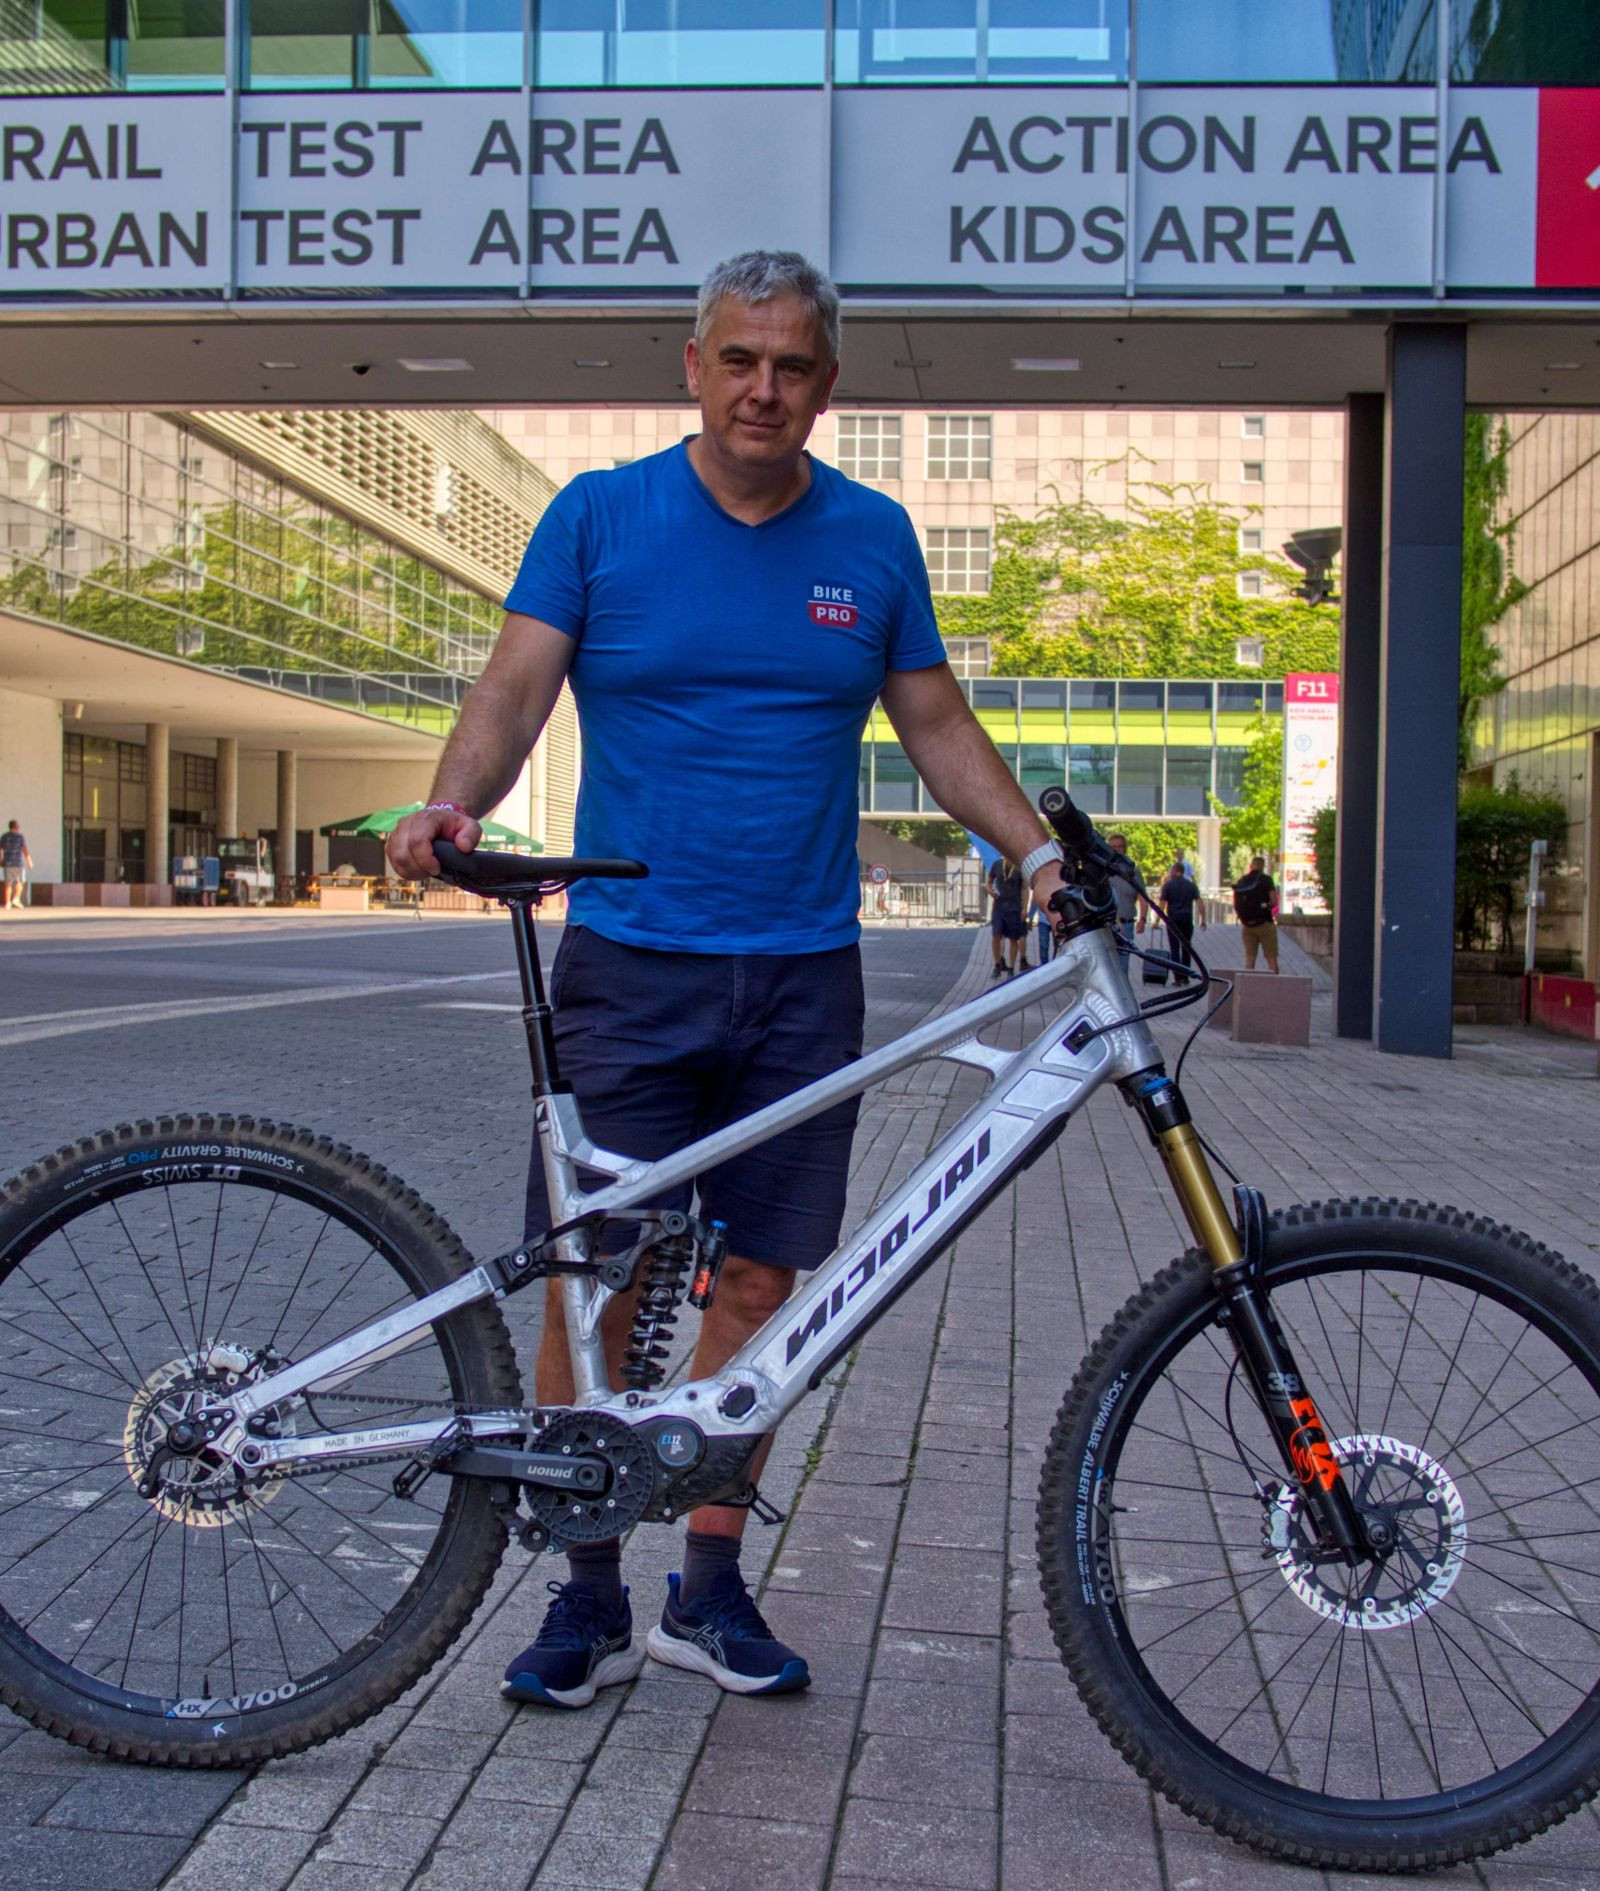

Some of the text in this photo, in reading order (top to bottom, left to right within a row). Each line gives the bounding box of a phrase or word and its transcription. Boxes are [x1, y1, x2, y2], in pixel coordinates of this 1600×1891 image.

[242, 120, 422, 178] TEST
[471, 118, 680, 176] AREA
[953, 115, 1501, 174] ACTION AREA
[0, 208, 679, 269] RBAN TEST AREA
[950, 206, 1354, 264] KIDS AREA
[813, 585, 853, 602] BIKE
[816, 606, 850, 622] PRO
[1297, 681, 1328, 697] F11
[874, 870, 886, 880] 30
[127, 1145, 295, 1171] SCHWALBE GRAVITY PRO
[142, 1163, 202, 1186] SWISS
[207, 1164, 242, 1181] DT
[786, 1127, 991, 1366] NICOLAI
[1267, 1371, 1301, 1392] 38
[324, 1429, 411, 1448] MADE IN GERMANY
[527, 1464, 575, 1479] pinion
[1075, 1380, 1124, 1542] SCHWALBE ALBERT TRAIL
[178, 1703, 202, 1713] HX
[229, 1682, 298, 1711] 1700
